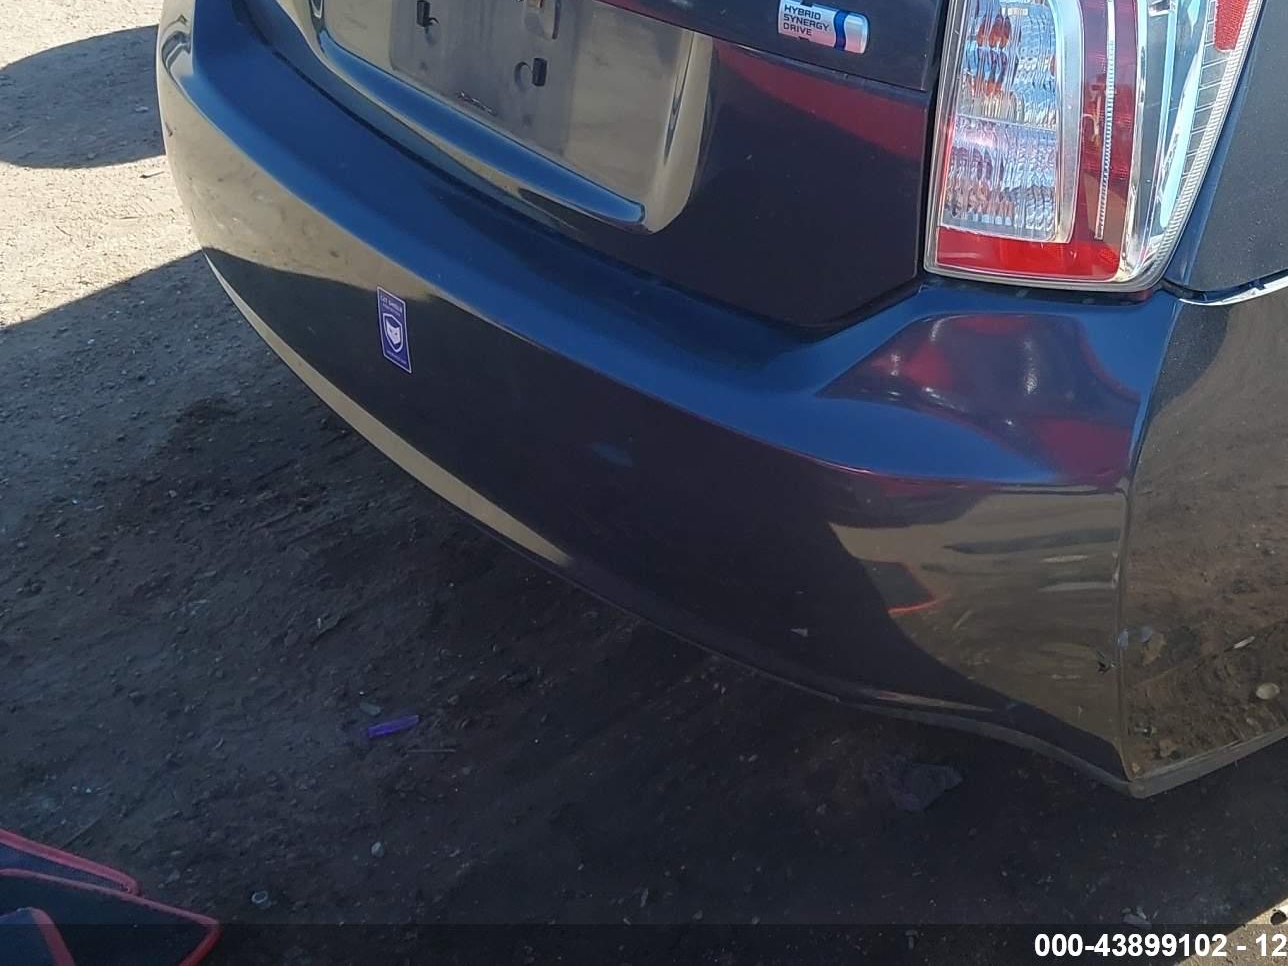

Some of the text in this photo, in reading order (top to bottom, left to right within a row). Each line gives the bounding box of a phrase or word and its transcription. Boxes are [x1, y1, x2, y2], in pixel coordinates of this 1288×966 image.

[784, 3, 822, 20] HYBRID
[783, 13, 830, 32] SYNERGY
[783, 22, 812, 36] DRIVE
